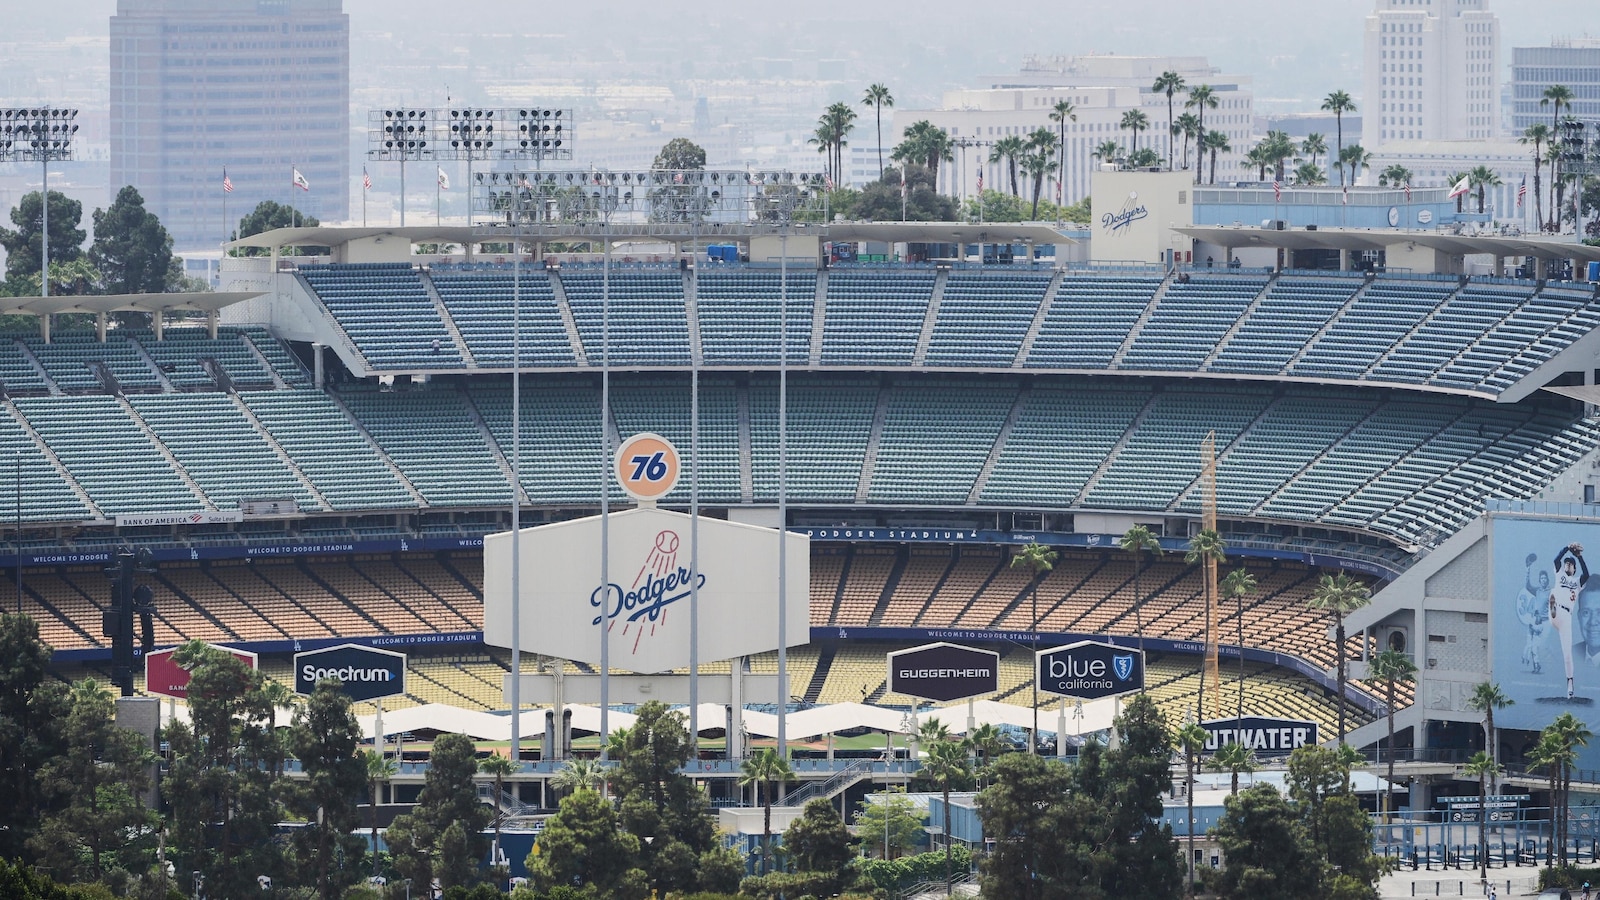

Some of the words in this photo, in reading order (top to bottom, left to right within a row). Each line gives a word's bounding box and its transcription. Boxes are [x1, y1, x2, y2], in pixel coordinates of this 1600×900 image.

[1102, 205, 1148, 230] Dodgers
[631, 453, 667, 480] 76
[807, 530, 874, 538] DODGER
[889, 530, 964, 539] STADIUM
[1173, 643, 1197, 651] WELCOME
[303, 664, 389, 682] Spectrum
[900, 669, 990, 678] GUGGENHEIM
[1050, 655, 1106, 678] blue
[1058, 679, 1113, 690] california
[1201, 728, 1307, 750] UTWATER
